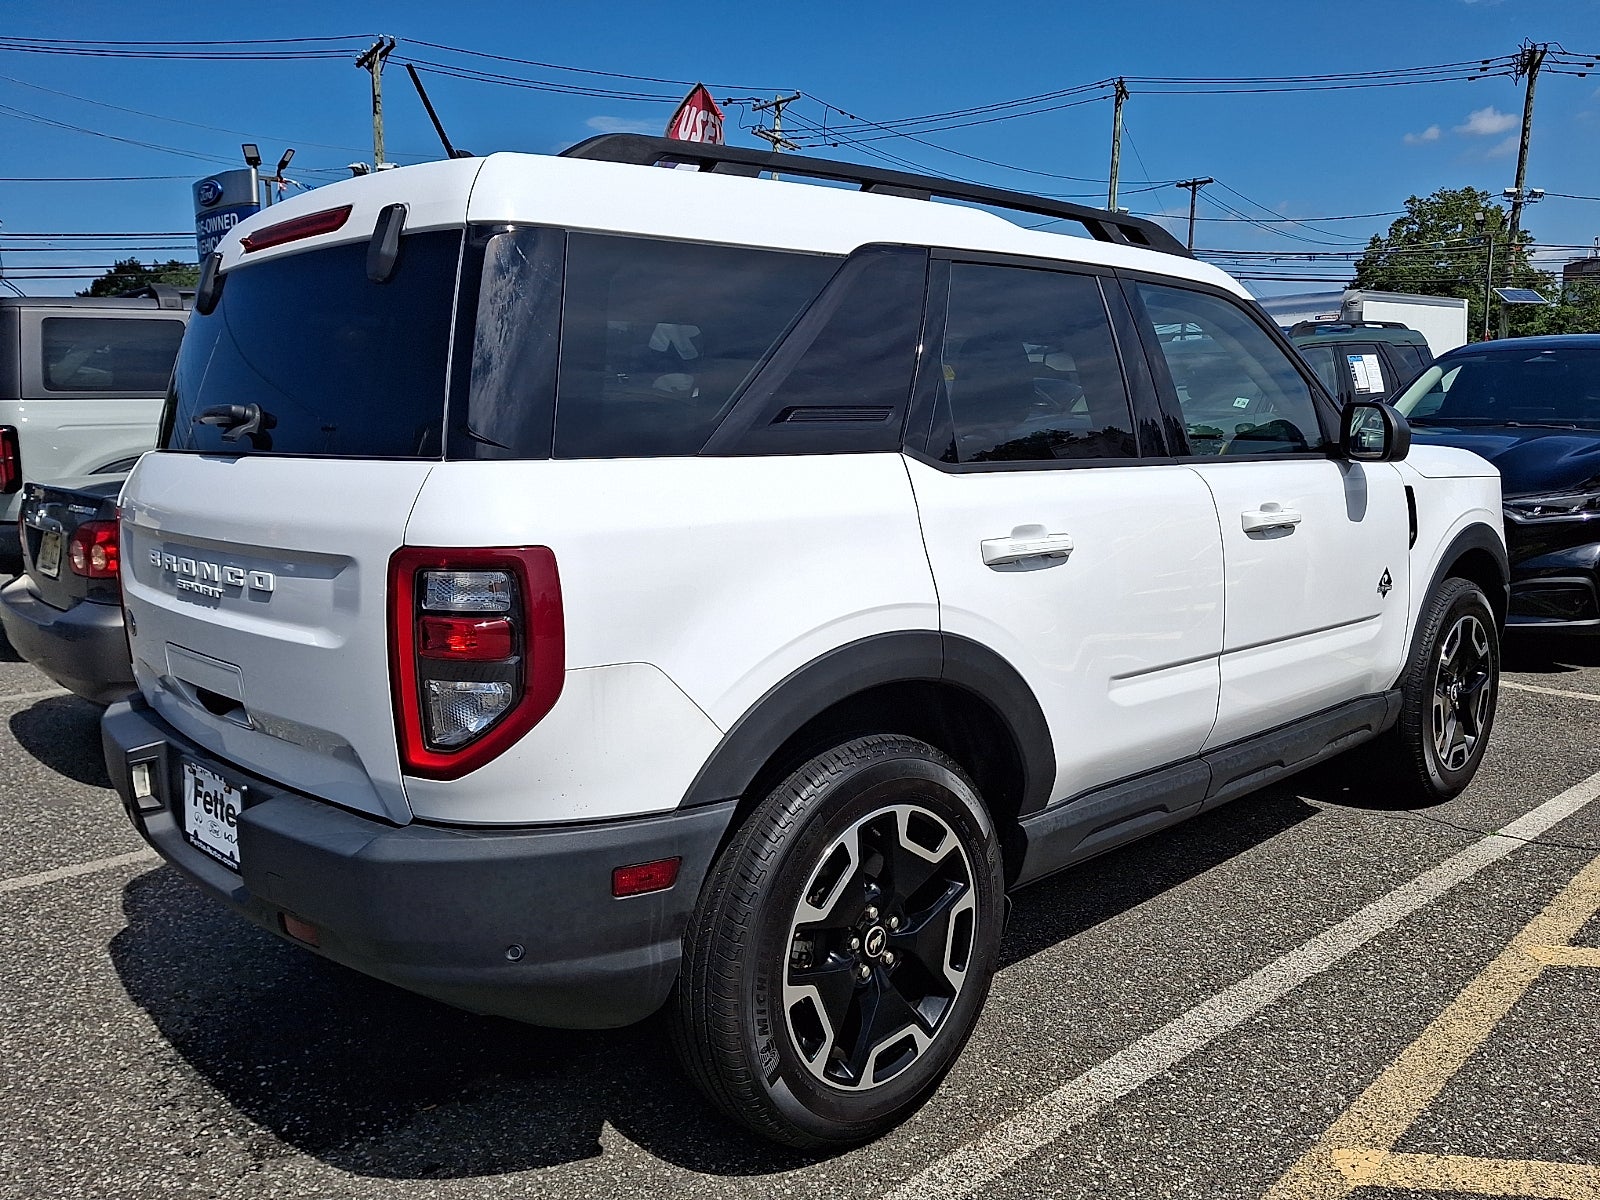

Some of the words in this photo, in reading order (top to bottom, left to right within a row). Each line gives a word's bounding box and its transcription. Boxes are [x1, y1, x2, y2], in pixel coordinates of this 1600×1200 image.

[678, 104, 724, 146] USED
[149, 549, 275, 593] BRONCO
[176, 578, 224, 599] SPORT
[193, 776, 237, 828] Fette
